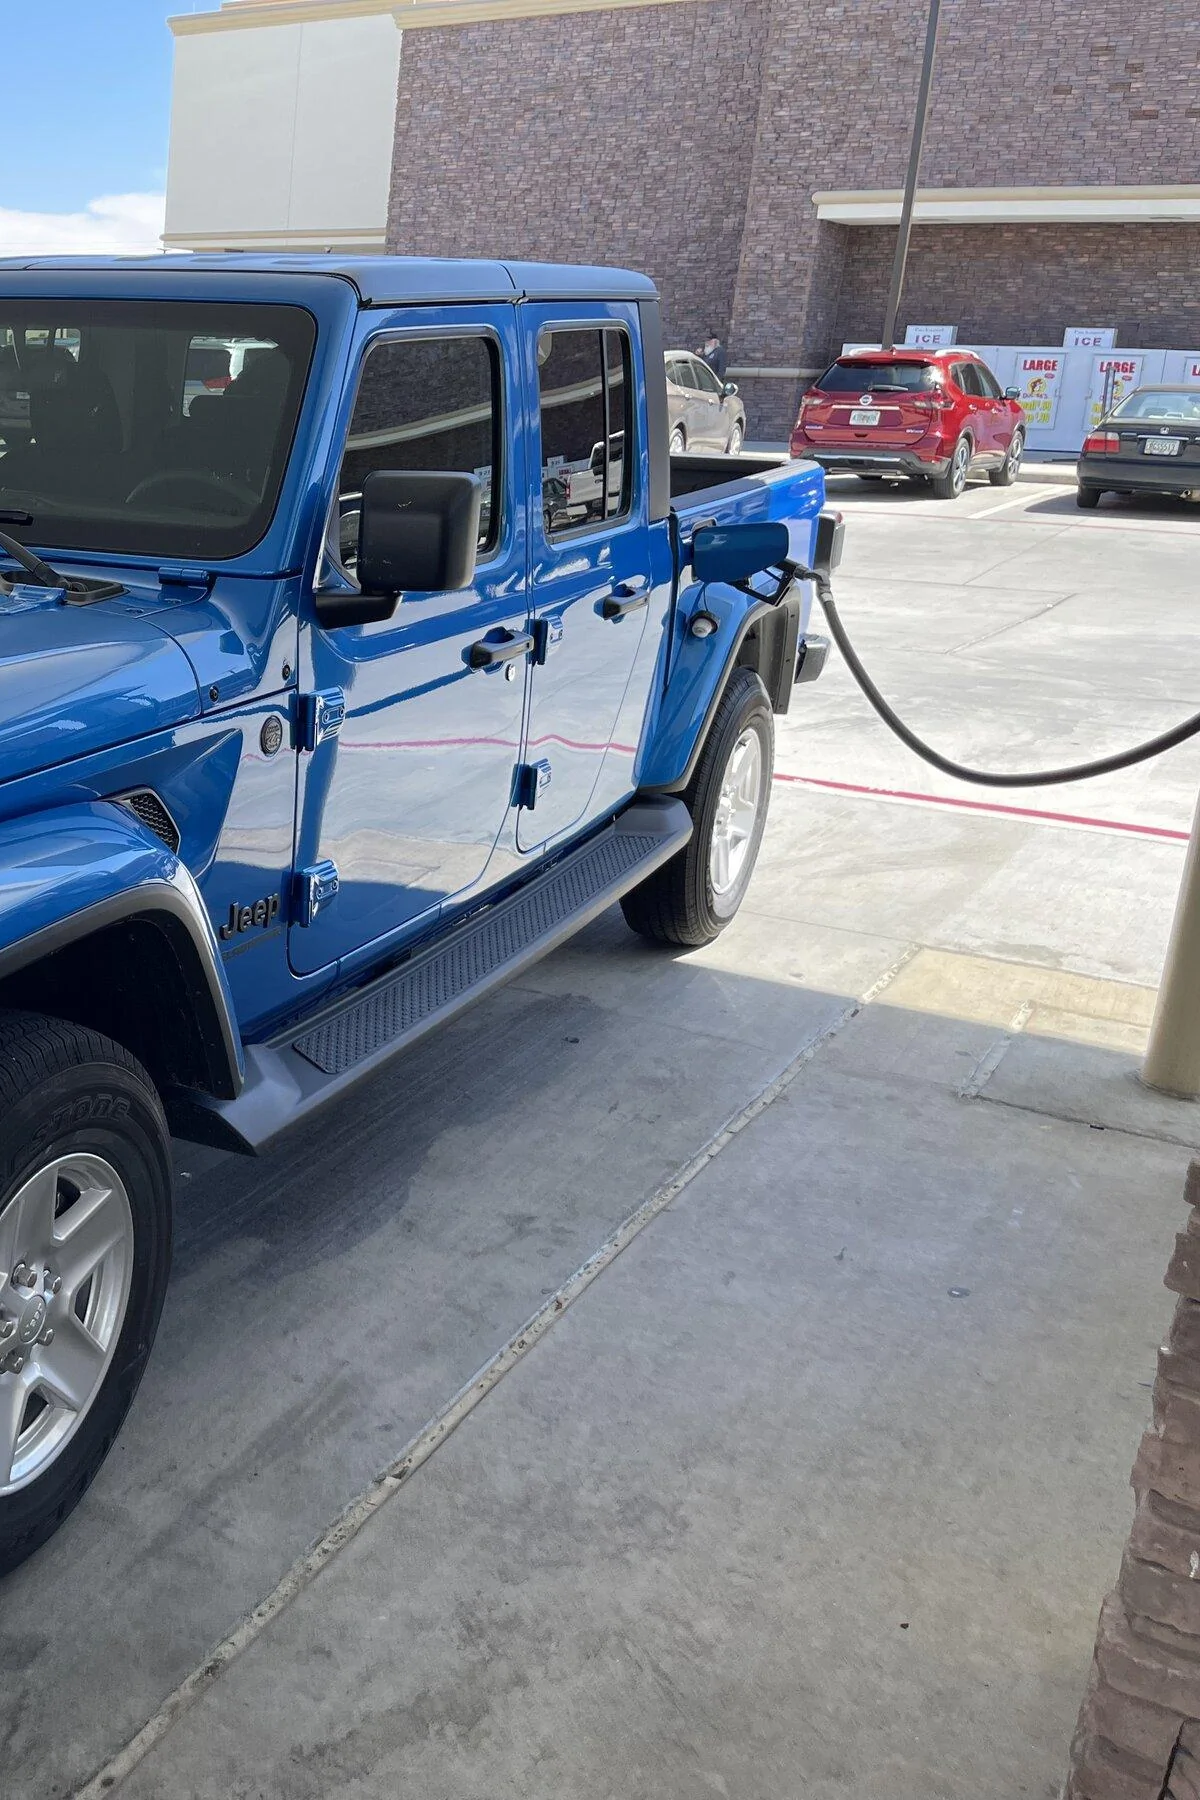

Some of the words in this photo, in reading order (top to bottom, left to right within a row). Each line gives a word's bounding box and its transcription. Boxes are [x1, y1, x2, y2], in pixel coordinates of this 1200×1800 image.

[915, 334, 941, 344] ICE
[1074, 337, 1102, 346] ICE
[1023, 359, 1058, 371] LARGE
[1099, 361, 1136, 374] LARGE
[220, 892, 281, 941] Jeep
